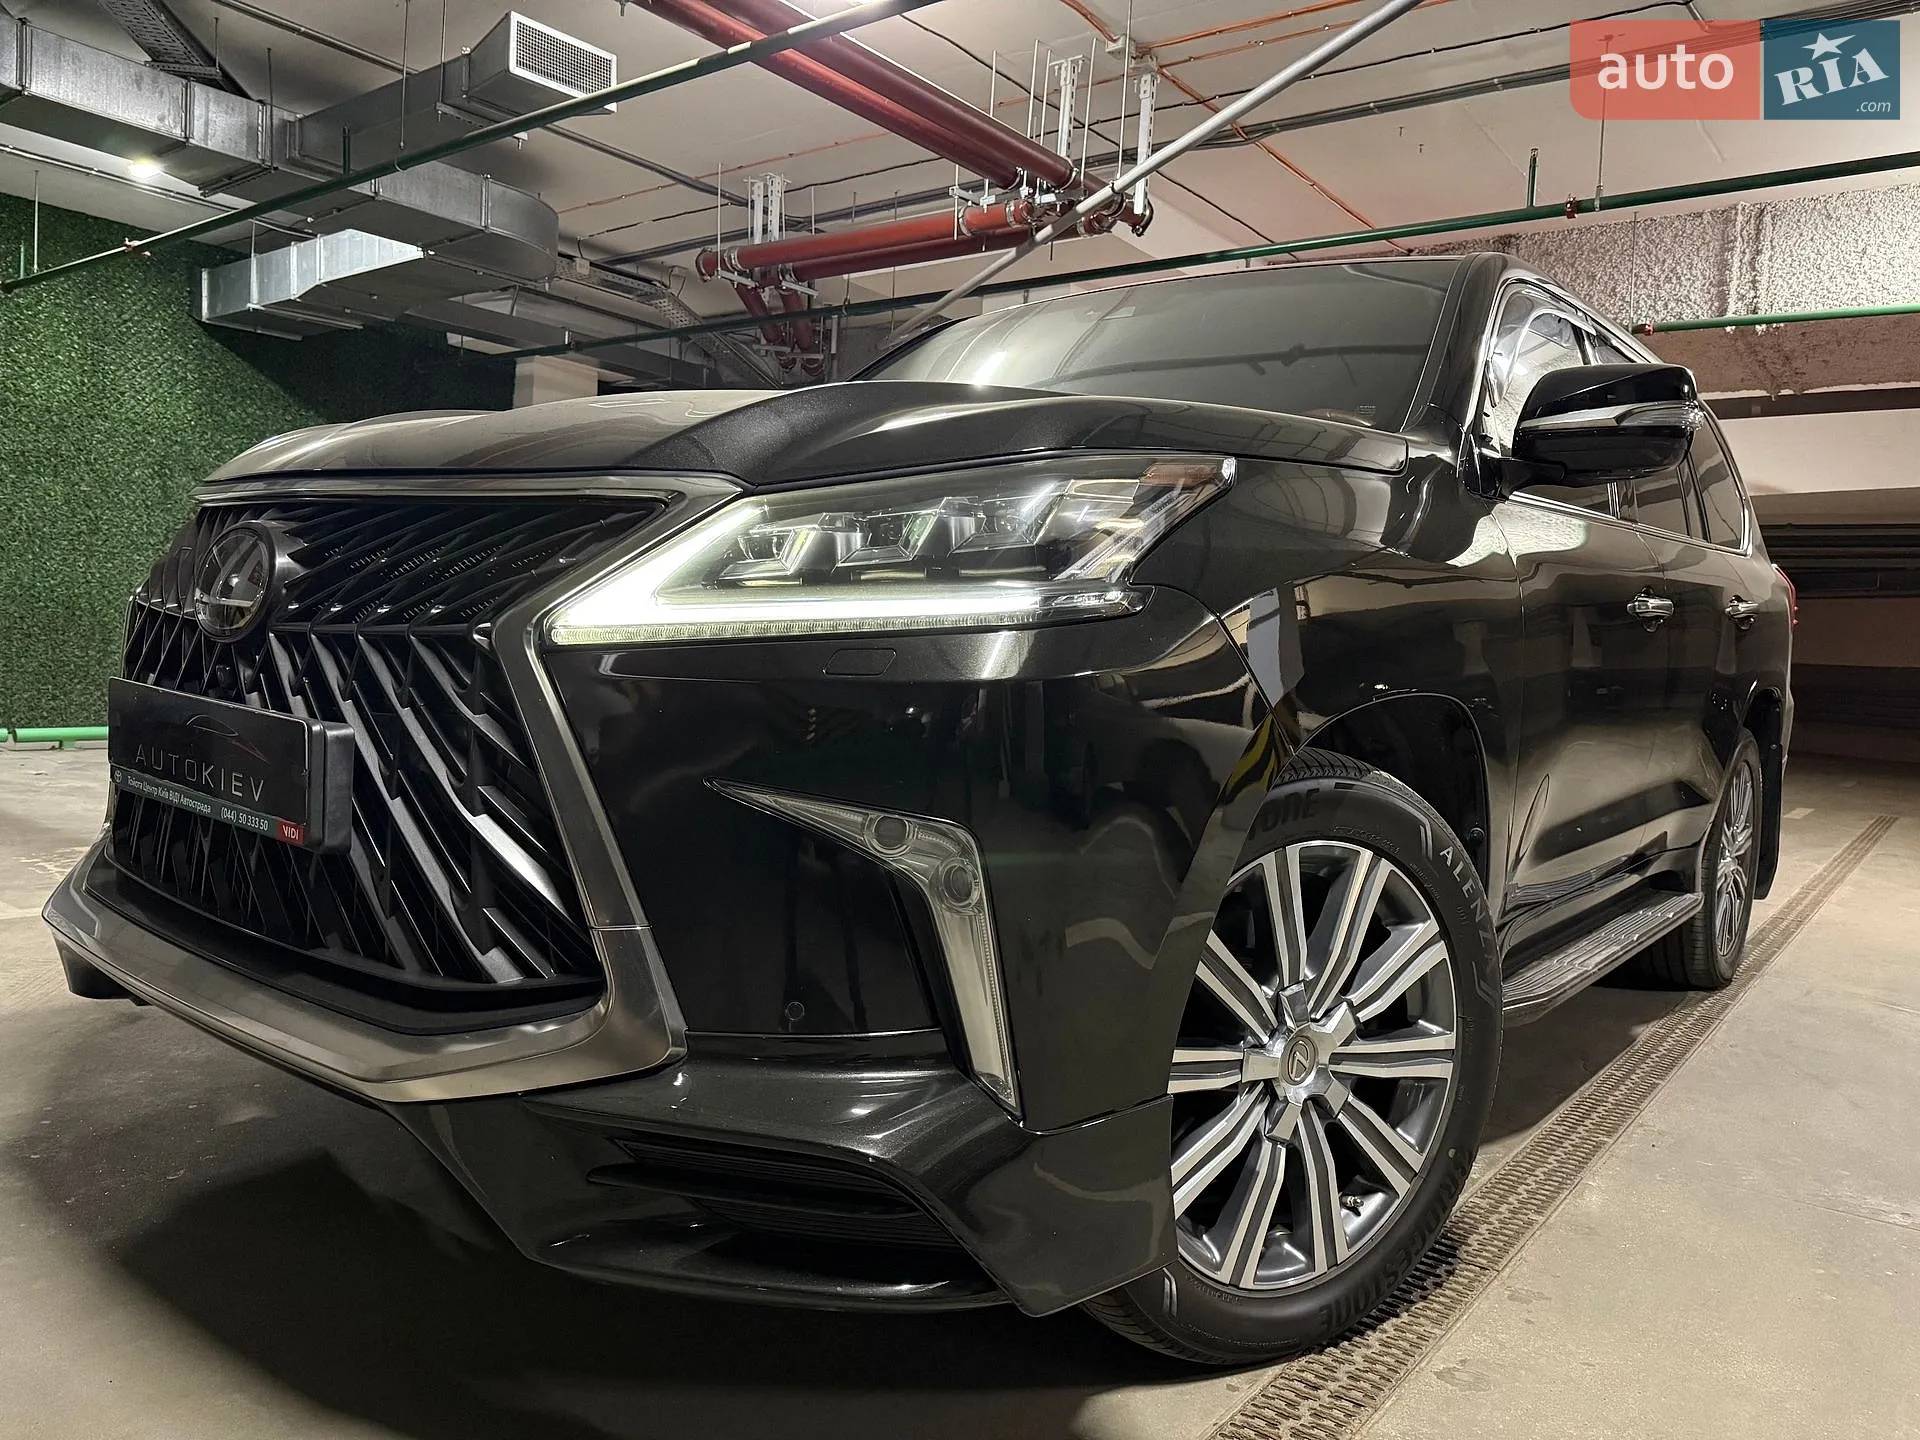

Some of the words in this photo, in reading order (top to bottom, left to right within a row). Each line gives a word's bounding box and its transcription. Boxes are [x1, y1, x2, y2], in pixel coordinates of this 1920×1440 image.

[135, 743, 265, 802] AUTOKIEV
[180, 794, 212, 814] Автострада
[221, 806, 237, 823] (044)
[282, 824, 299, 840] VIDI
